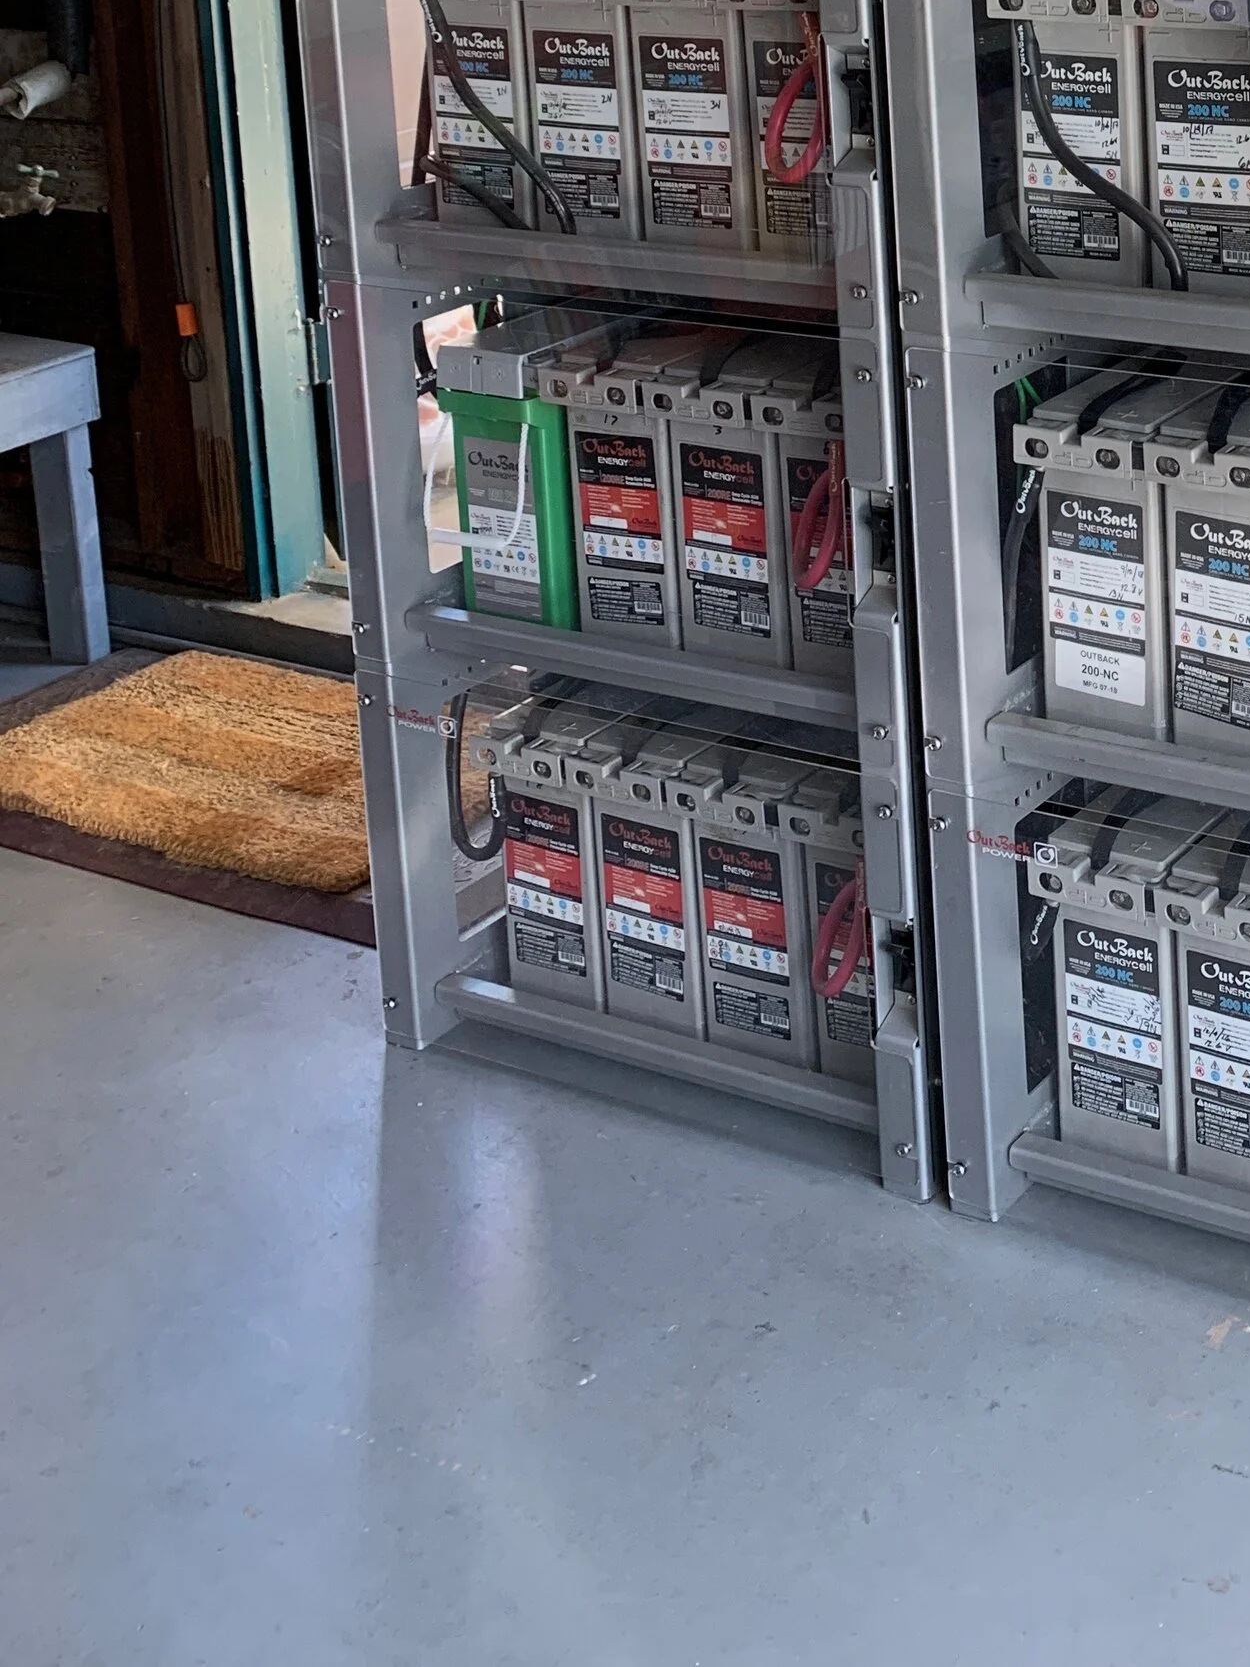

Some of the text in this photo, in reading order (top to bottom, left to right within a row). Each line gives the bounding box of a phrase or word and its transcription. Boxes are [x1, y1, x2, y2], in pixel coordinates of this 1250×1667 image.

[544, 37, 610, 57] OutBack
[651, 42, 720, 61] OutBack
[559, 56, 610, 67] ENERGYcell
[667, 62, 720, 72] ENERGYcell
[561, 68, 594, 81] 200 NC
[668, 73, 703, 86] 200 NC
[1168, 68, 1250, 90] OutBack
[1051, 82, 1112, 94] ENERGYcell
[1052, 95, 1091, 109] 200 NC
[1186, 91, 1250, 103] ENERGYcell
[1187, 104, 1230, 118] 200 NC
[713, 425, 722, 435] 3
[582, 438, 646, 458] OutBack
[688, 451, 754, 474] OutBack
[1060, 500, 1138, 529] OutBack
[1077, 522, 1137, 540] ENERGYcell
[1078, 535, 1118, 552] 200 NC
[1208, 557, 1250, 577] 200 NC
[1080, 650, 1120, 666] OUTBACK
[1081, 663, 1119, 682] 200-NC
[1082, 679, 1118, 694] MFG 07-18
[397, 720, 436, 733] POWER
[967, 830, 1031, 854] OutBack
[982, 847, 1031, 862] POWER
[1077, 930, 1154, 962] OutBack
[1094, 952, 1153, 973] ENERGYcell
[1095, 963, 1134, 983] 200 NC
[1219, 996, 1241, 1012] 200
